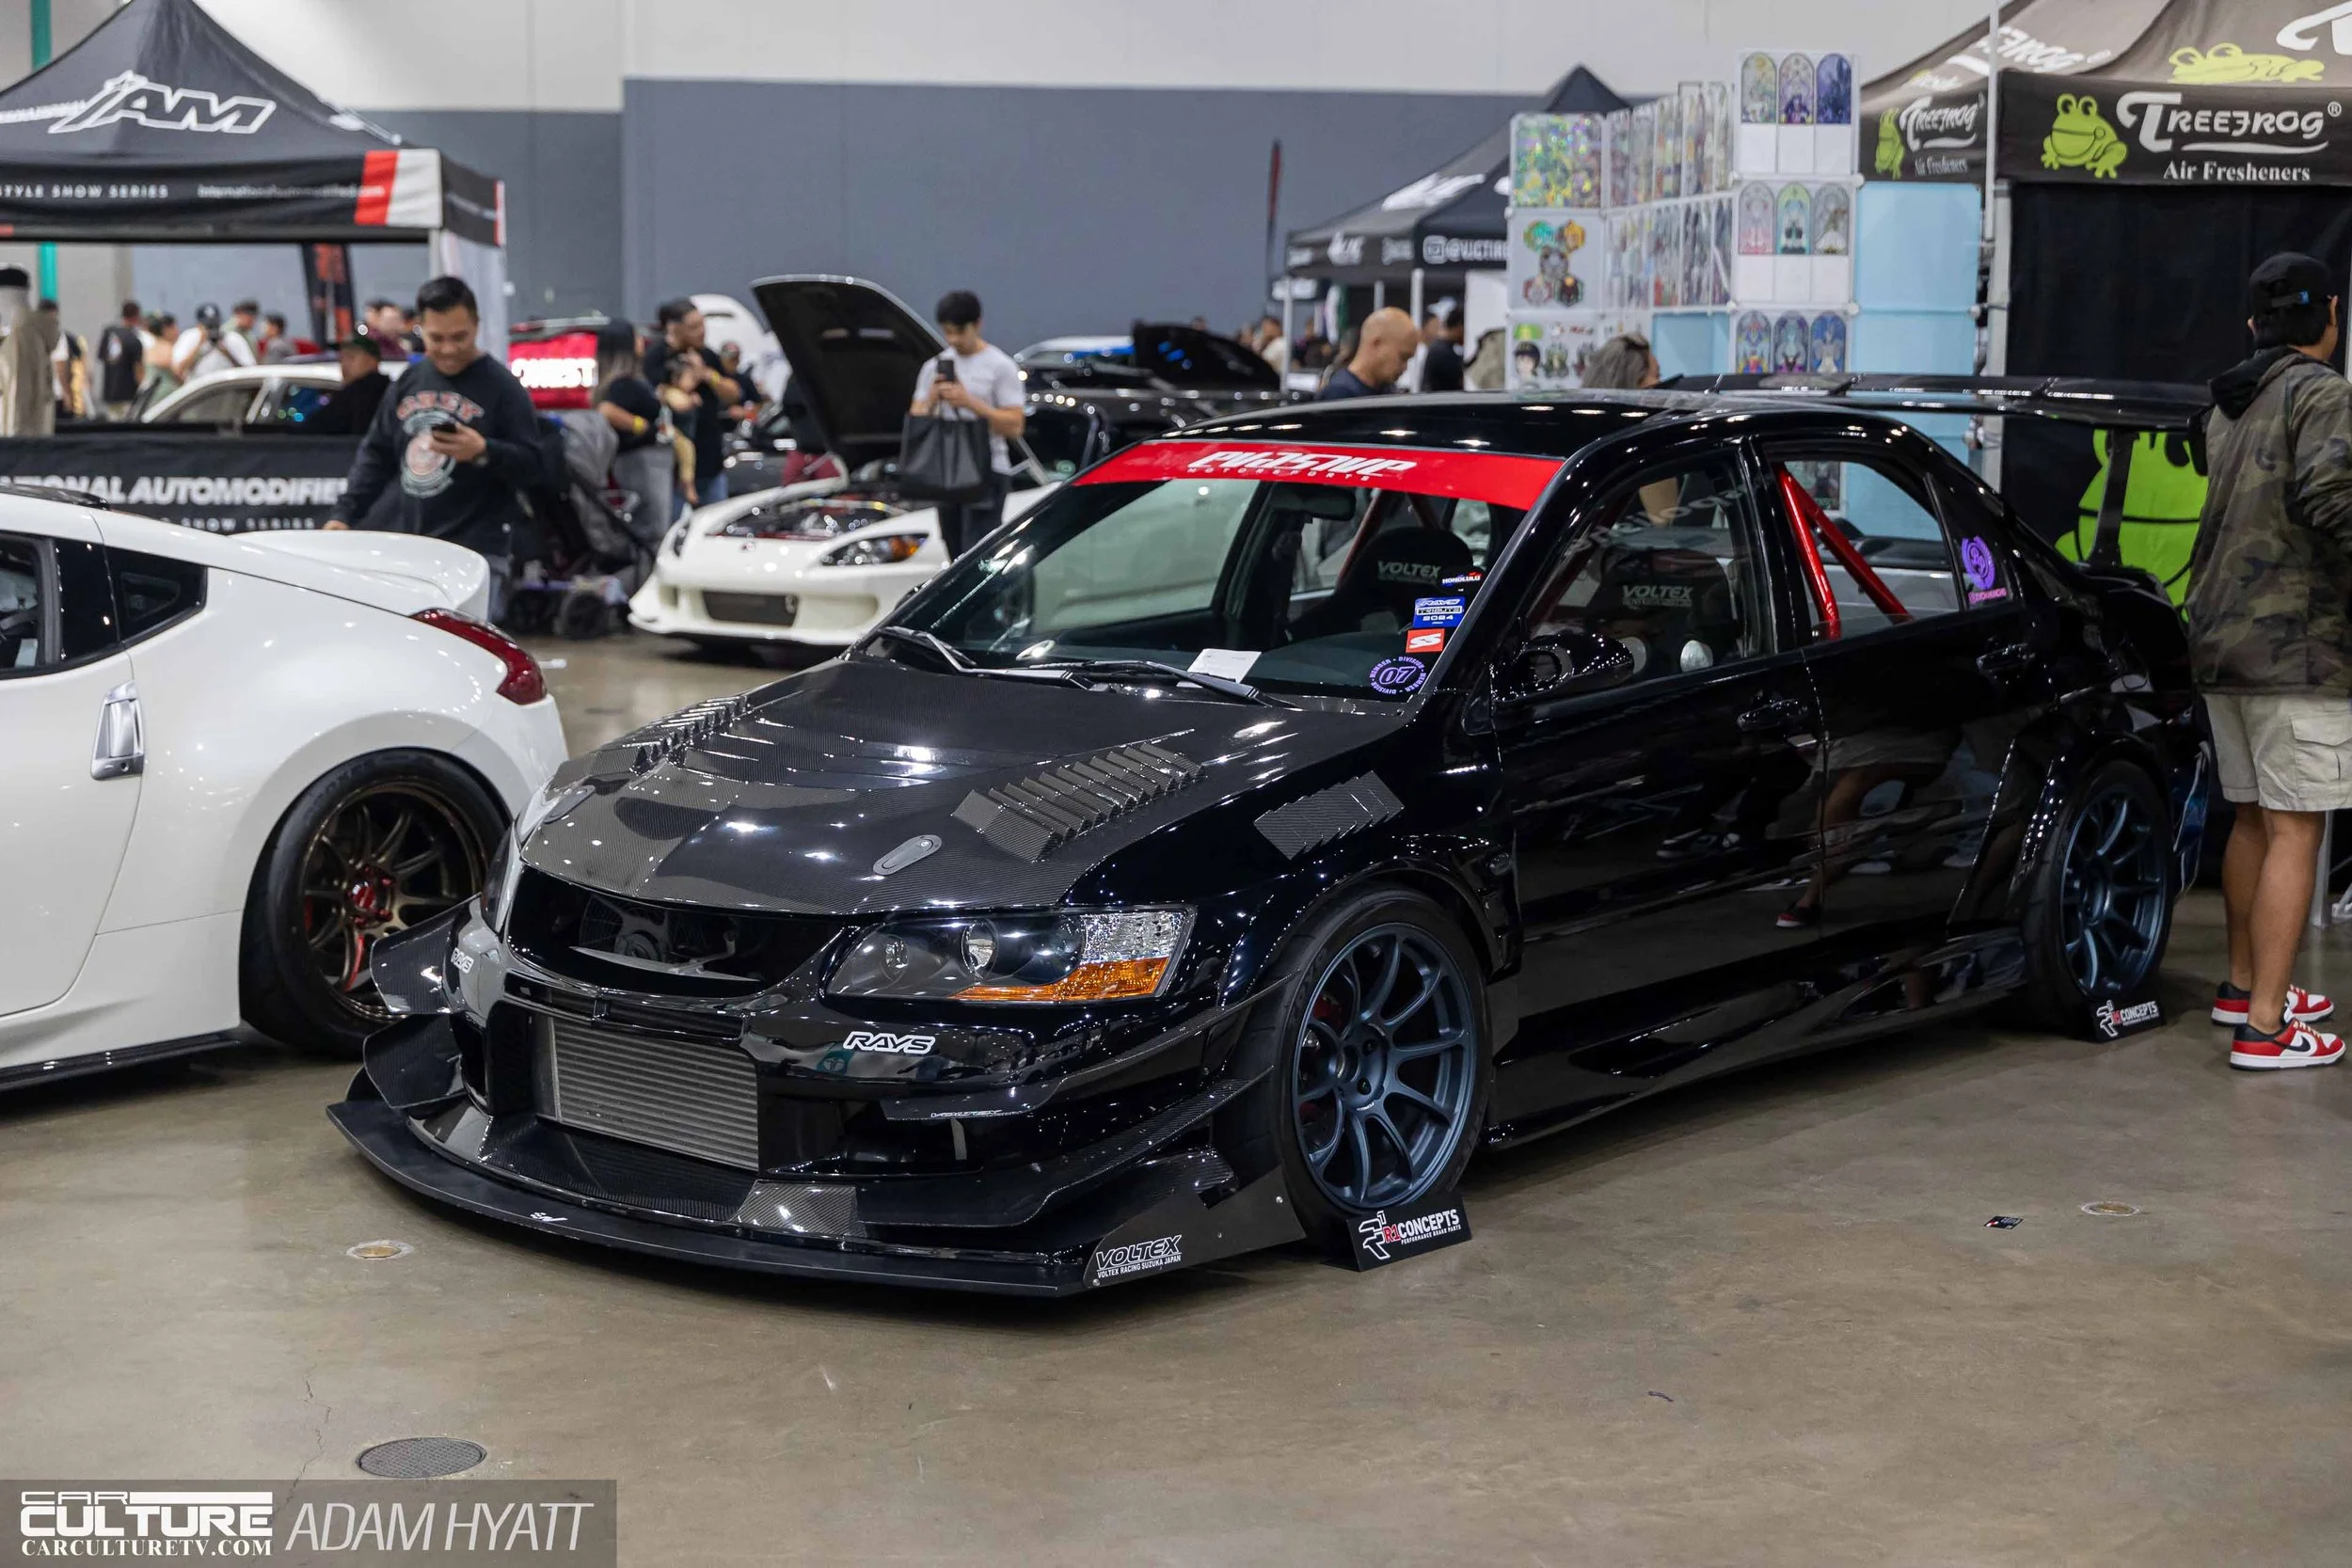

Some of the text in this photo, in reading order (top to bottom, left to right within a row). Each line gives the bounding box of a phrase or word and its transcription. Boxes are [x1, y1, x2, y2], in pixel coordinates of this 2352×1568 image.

[2164, 161, 2311, 181] Air Fresheners
[0, 183, 168, 198] TYLE SHOW SERIES
[128, 475, 348, 505] AUTOMODIFIE
[1378, 561, 1441, 578] VOLTEX
[1442, 575, 1481, 584] HONOLULU
[1623, 585, 1693, 600] VOLTEX
[1378, 666, 1417, 685] 07
[451, 947, 474, 974] RAYS
[843, 1031, 936, 1054] RAYS
[1401, 1224, 1462, 1244] PERFORMANCE BRAKE PARTS
[1095, 1234, 1183, 1271] VOLTEX
[1097, 1254, 1182, 1278] VOLTEX RACING SUZUKA JAPAN
